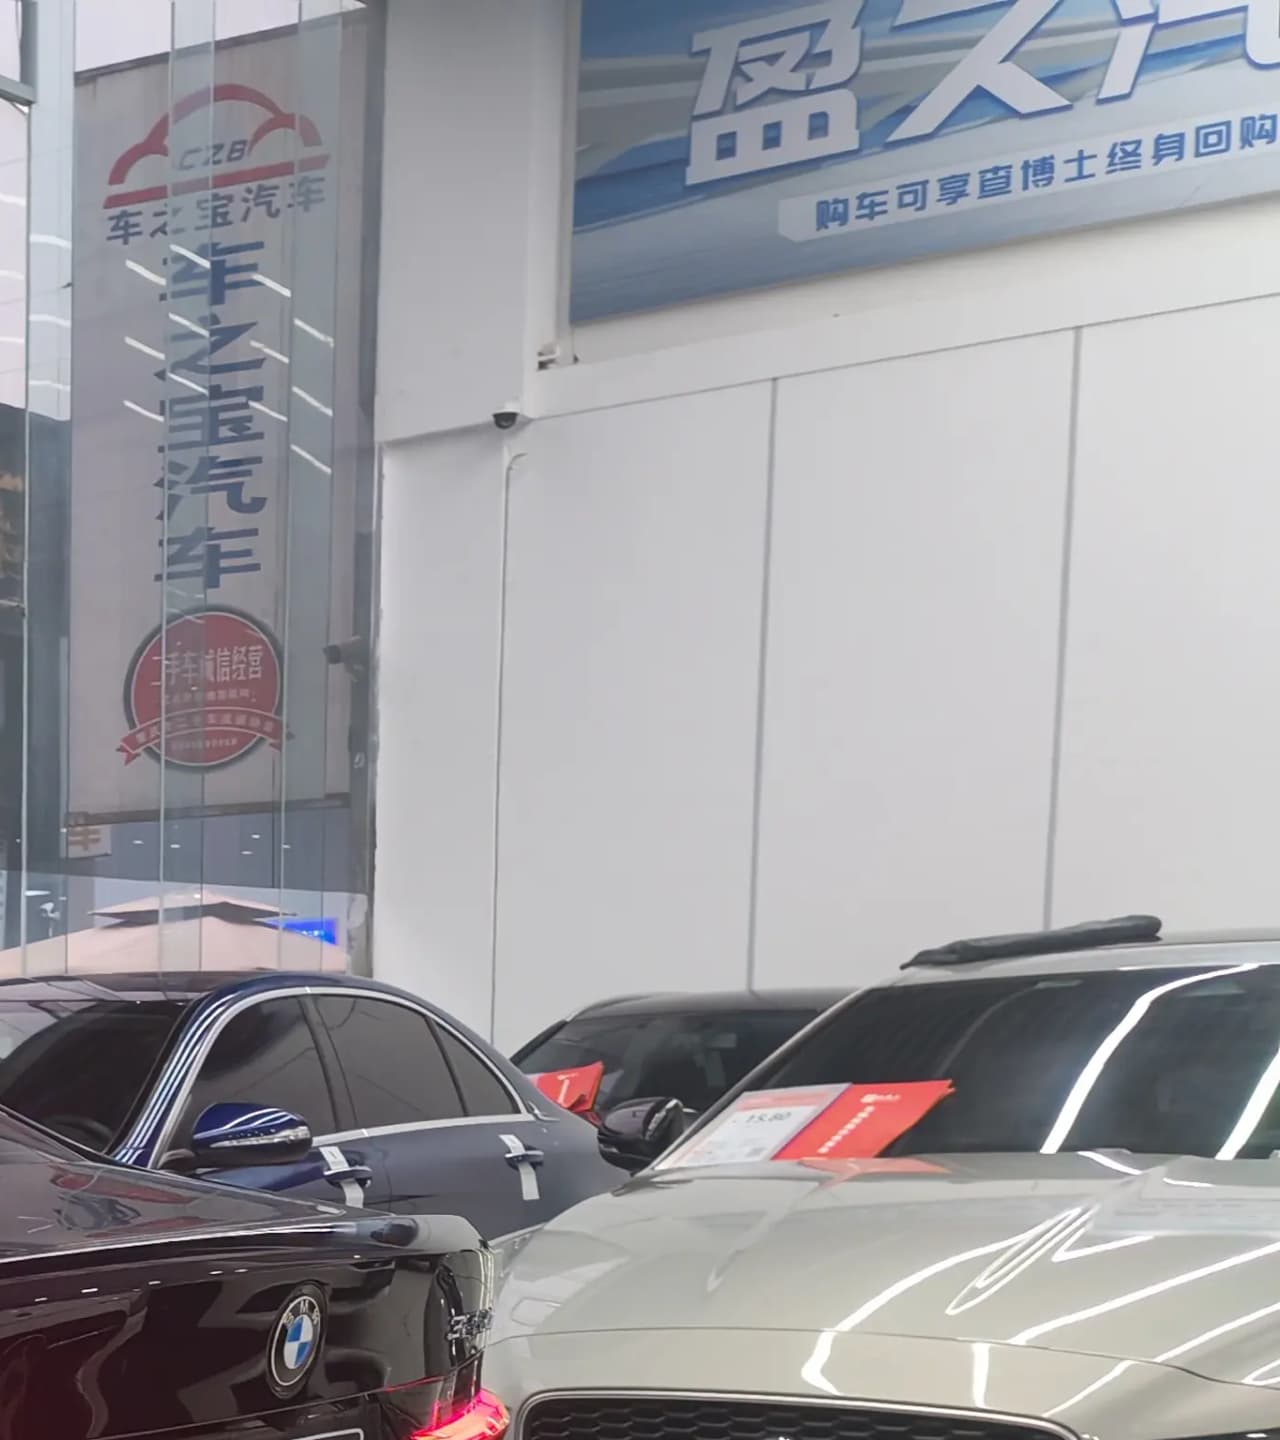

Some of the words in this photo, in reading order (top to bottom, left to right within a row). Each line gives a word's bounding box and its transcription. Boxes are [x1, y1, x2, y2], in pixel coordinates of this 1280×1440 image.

[683, 0, 1280, 187] 盈久
[106, 175, 326, 246] 车之宝汽车
[177, 139, 249, 171] CZB
[815, 113, 1279, 231] 购车可享查博士终身回购
[153, 240, 268, 590] 车之宝汽车
